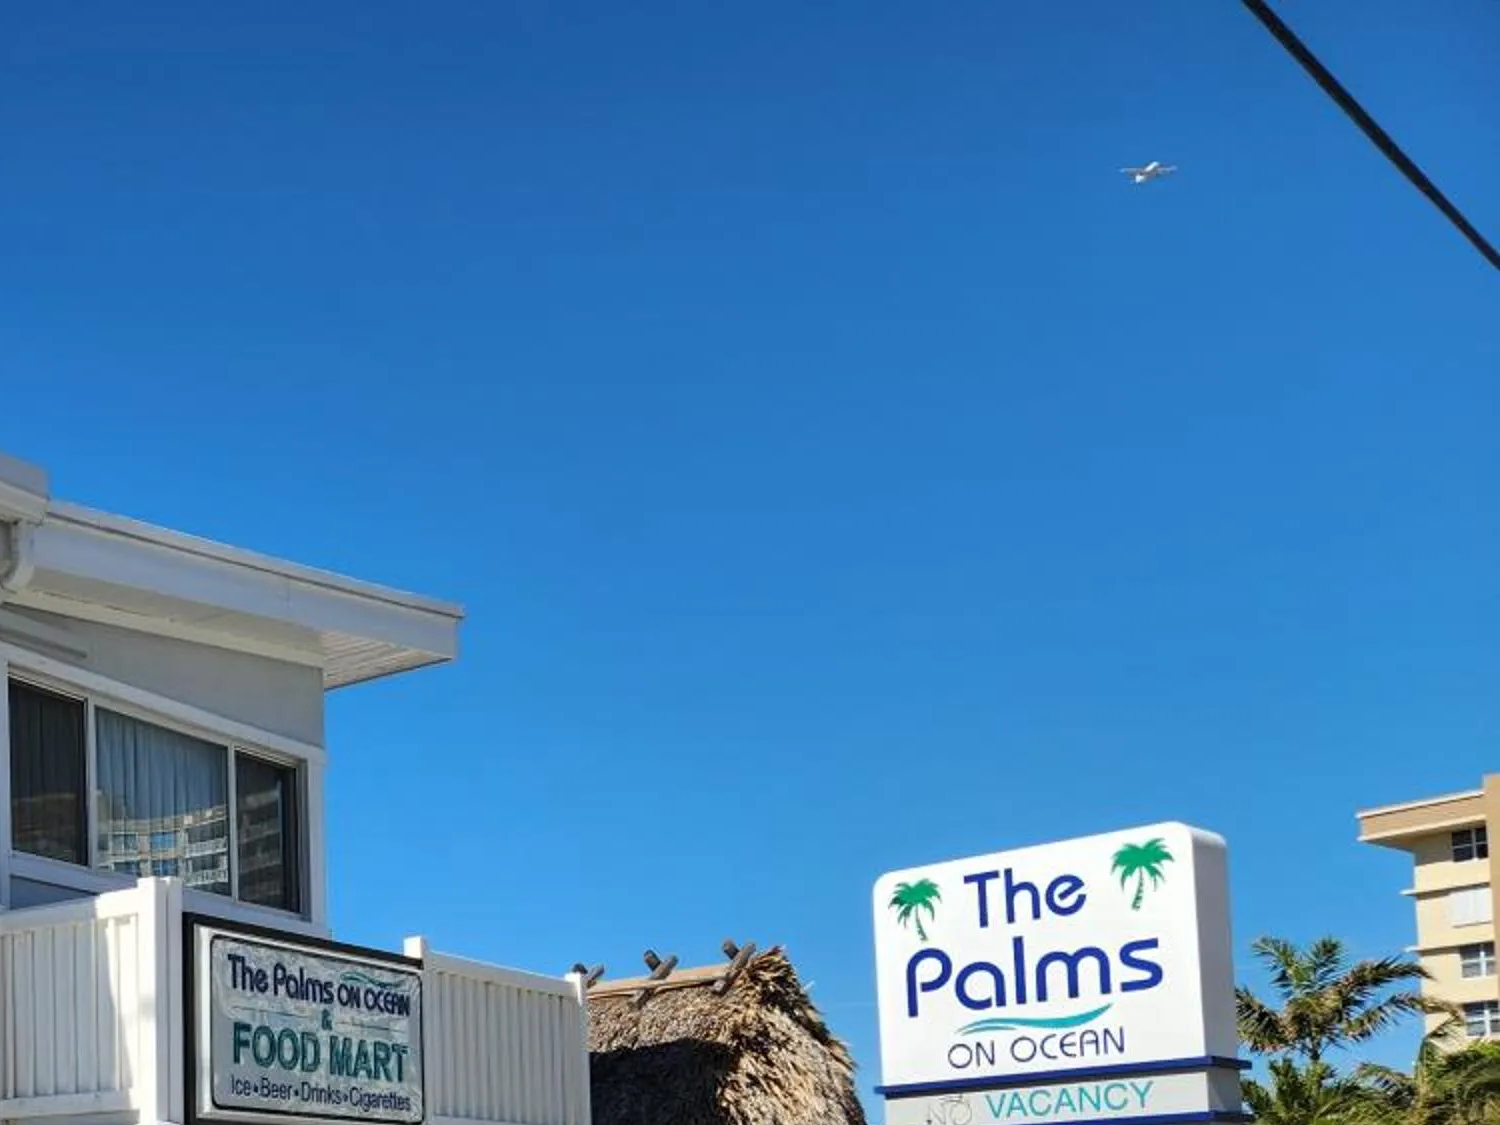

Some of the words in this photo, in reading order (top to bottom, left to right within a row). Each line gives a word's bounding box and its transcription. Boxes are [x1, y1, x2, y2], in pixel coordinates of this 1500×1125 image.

[964, 868, 1086, 928] The
[228, 954, 269, 994] The
[274, 963, 335, 1004] Palms
[338, 984, 361, 1009] ON
[364, 987, 411, 1017] OCEAN
[906, 936, 1163, 1018] Palms
[321, 1009, 333, 1031] &
[232, 1021, 321, 1073] FOOD
[329, 1035, 409, 1083] MART
[948, 1040, 996, 1069] ON
[1010, 1027, 1125, 1062] OCEAN
[231, 1075, 251, 1097] Ice
[261, 1078, 293, 1101] Beer
[302, 1081, 342, 1105] Drinks
[350, 1086, 412, 1114] Cigarettes
[985, 1080, 1154, 1120] VACANCY
